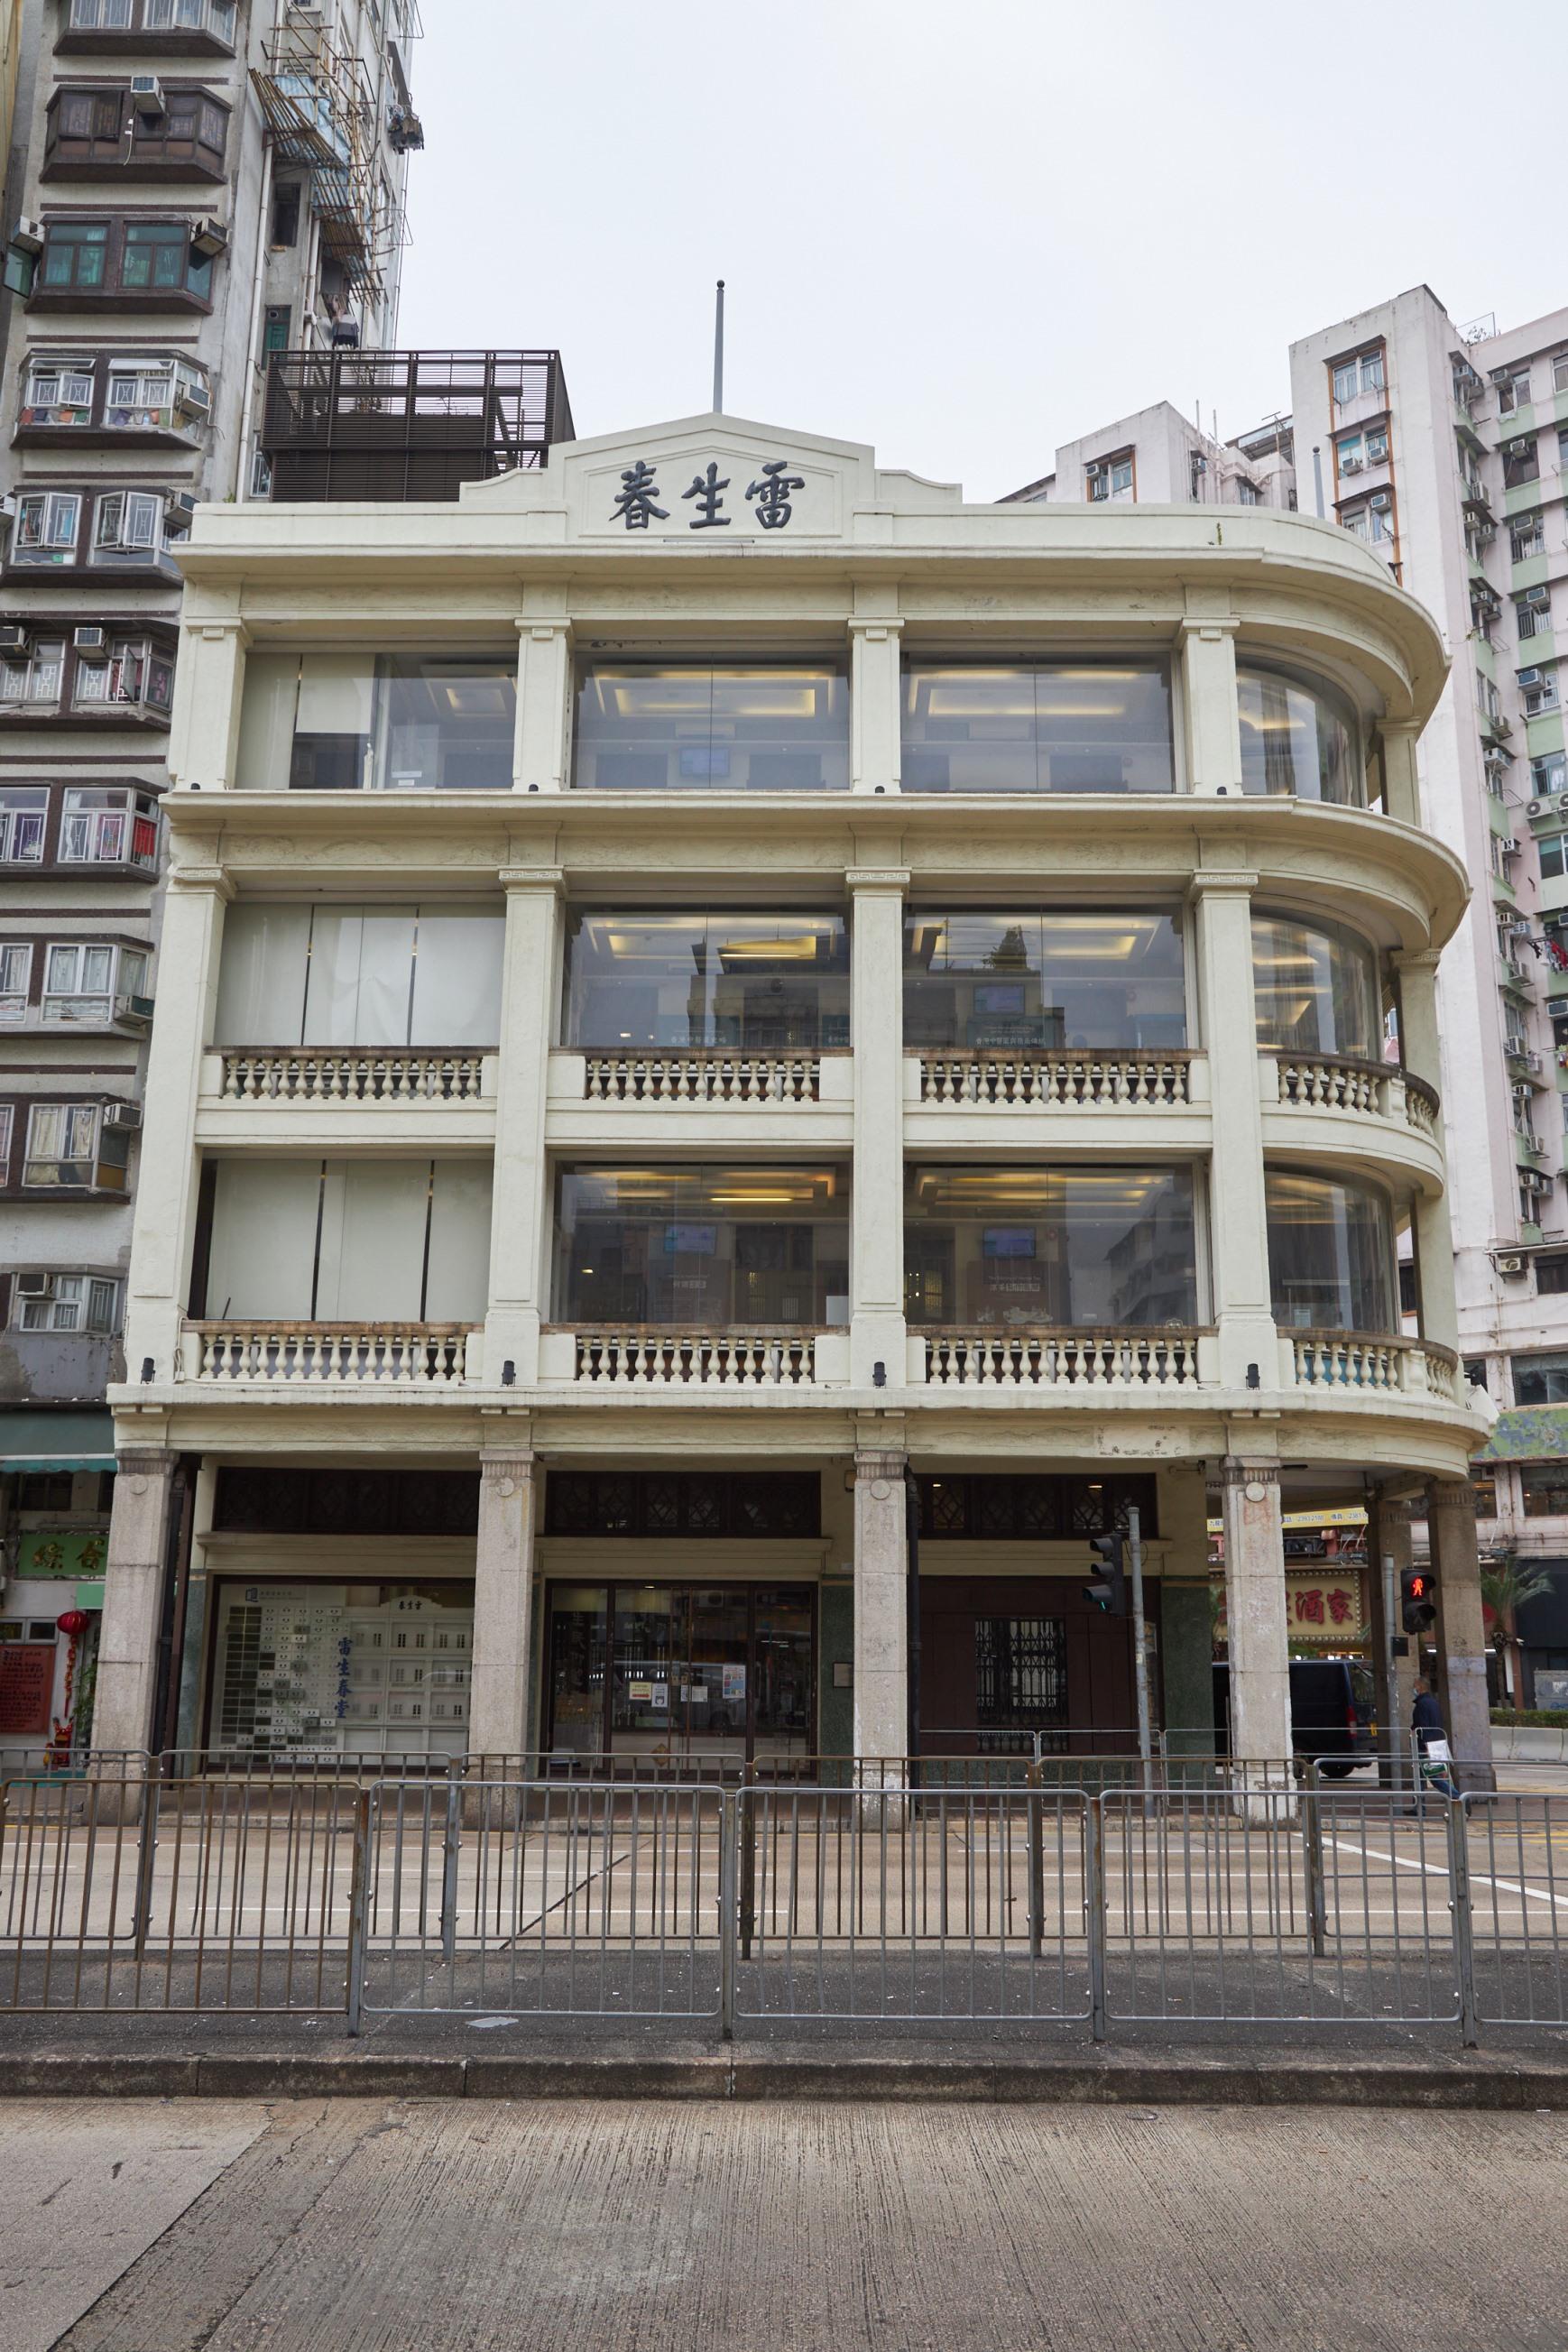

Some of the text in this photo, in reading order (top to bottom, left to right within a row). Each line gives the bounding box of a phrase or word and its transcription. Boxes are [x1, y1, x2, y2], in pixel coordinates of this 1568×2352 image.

[1286, 1589, 1353, 1625] 酒家
[333, 1637, 354, 1720] 雷生春堂
